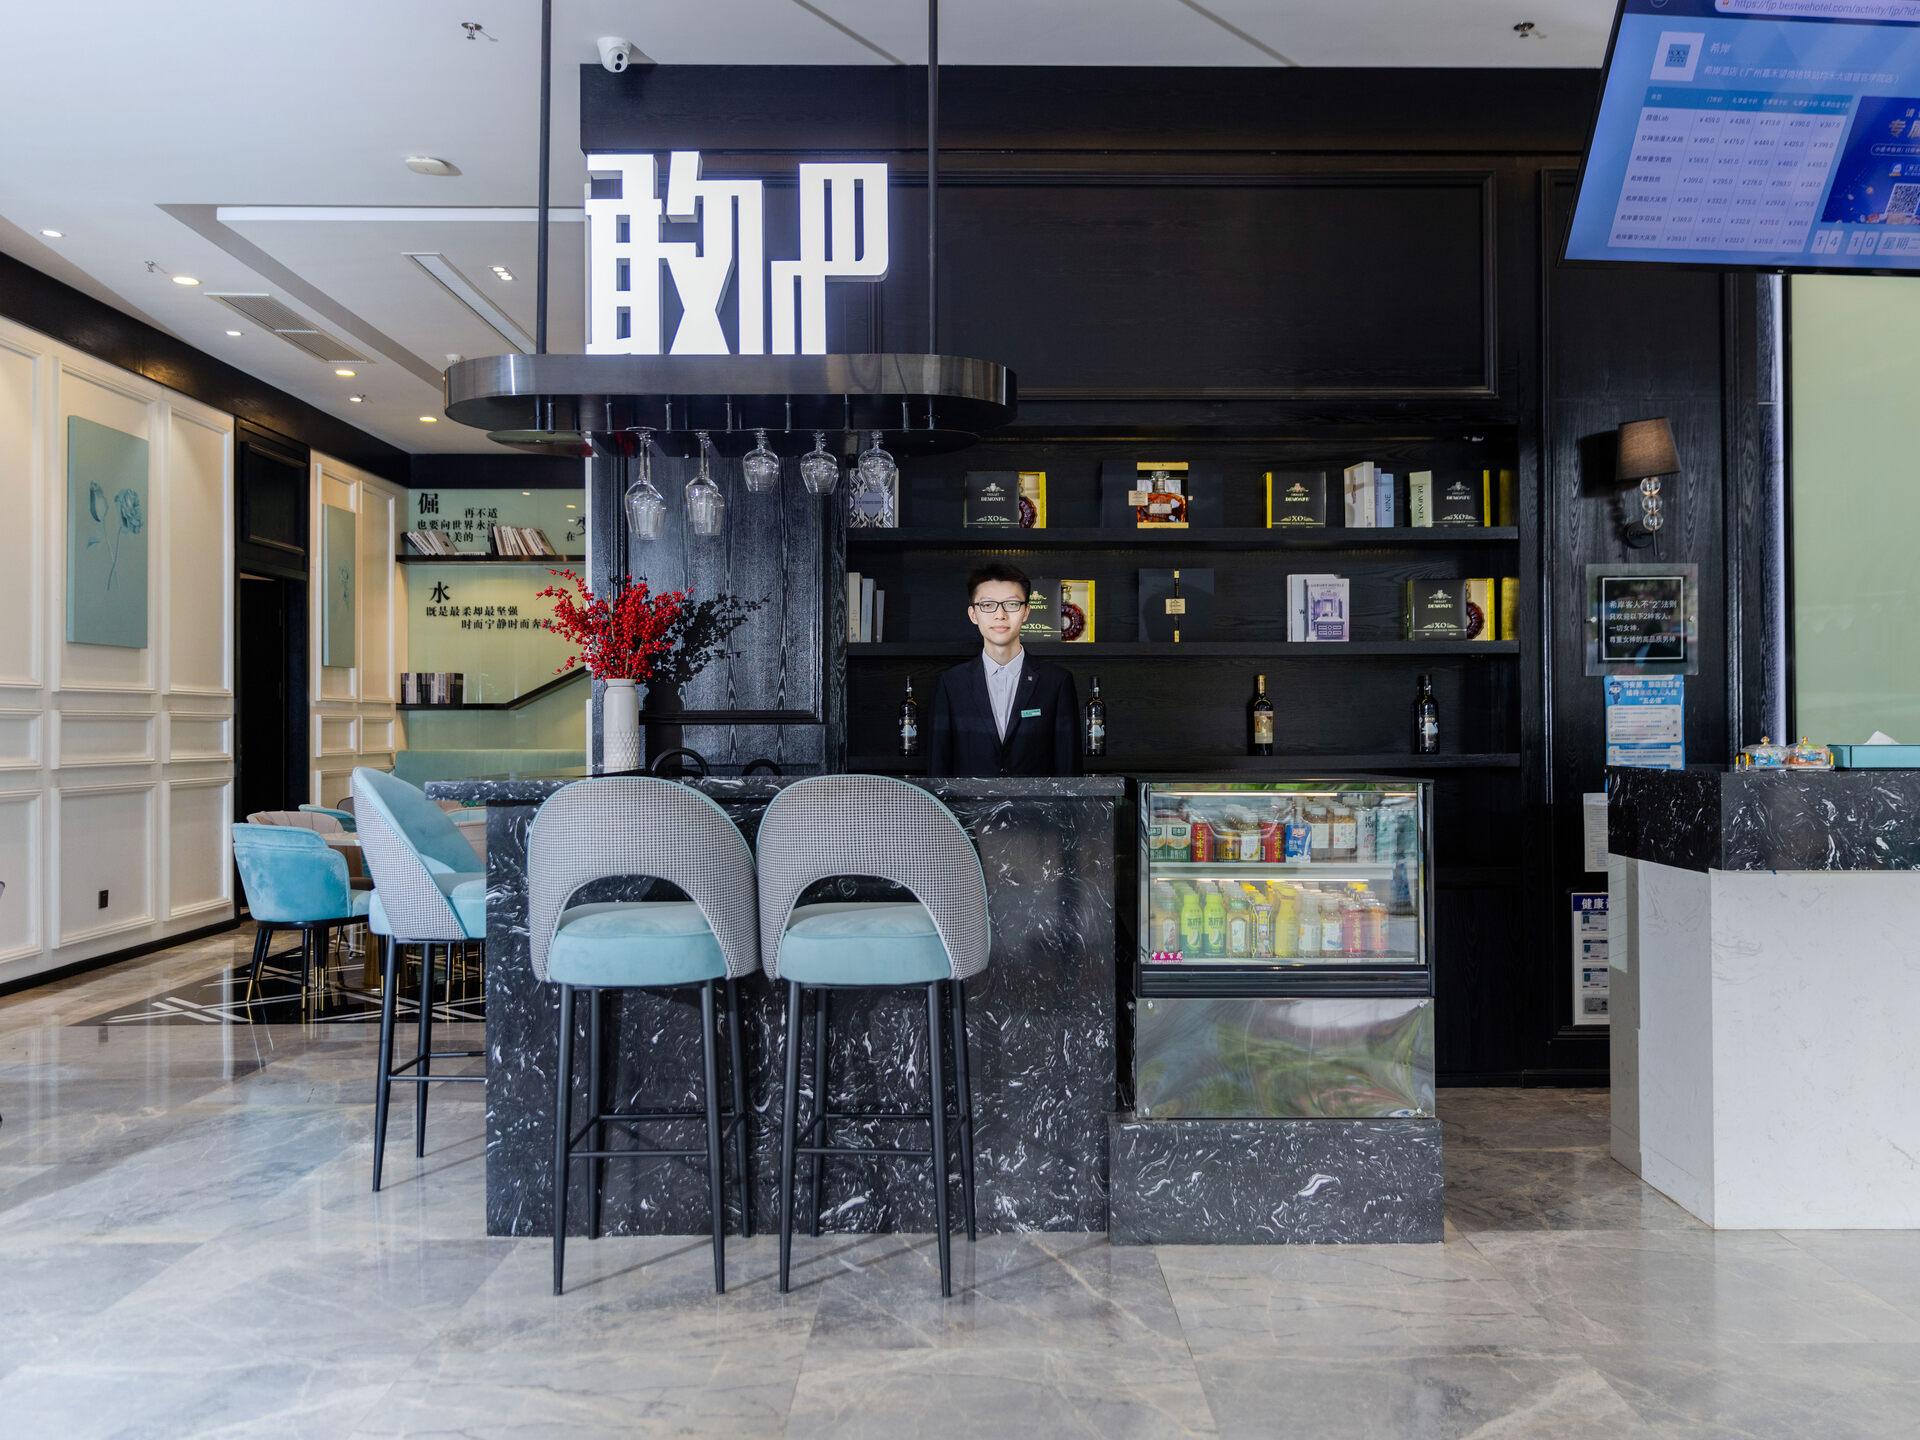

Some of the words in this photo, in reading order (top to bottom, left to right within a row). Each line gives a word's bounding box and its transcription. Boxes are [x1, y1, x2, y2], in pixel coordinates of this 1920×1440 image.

[418, 493, 438, 515] 倔
[1384, 494, 1392, 512] NINE
[429, 581, 450, 604] 水
[426, 605, 518, 617] 既是最柔却最坚强
[1582, 898, 1608, 909] 健康
